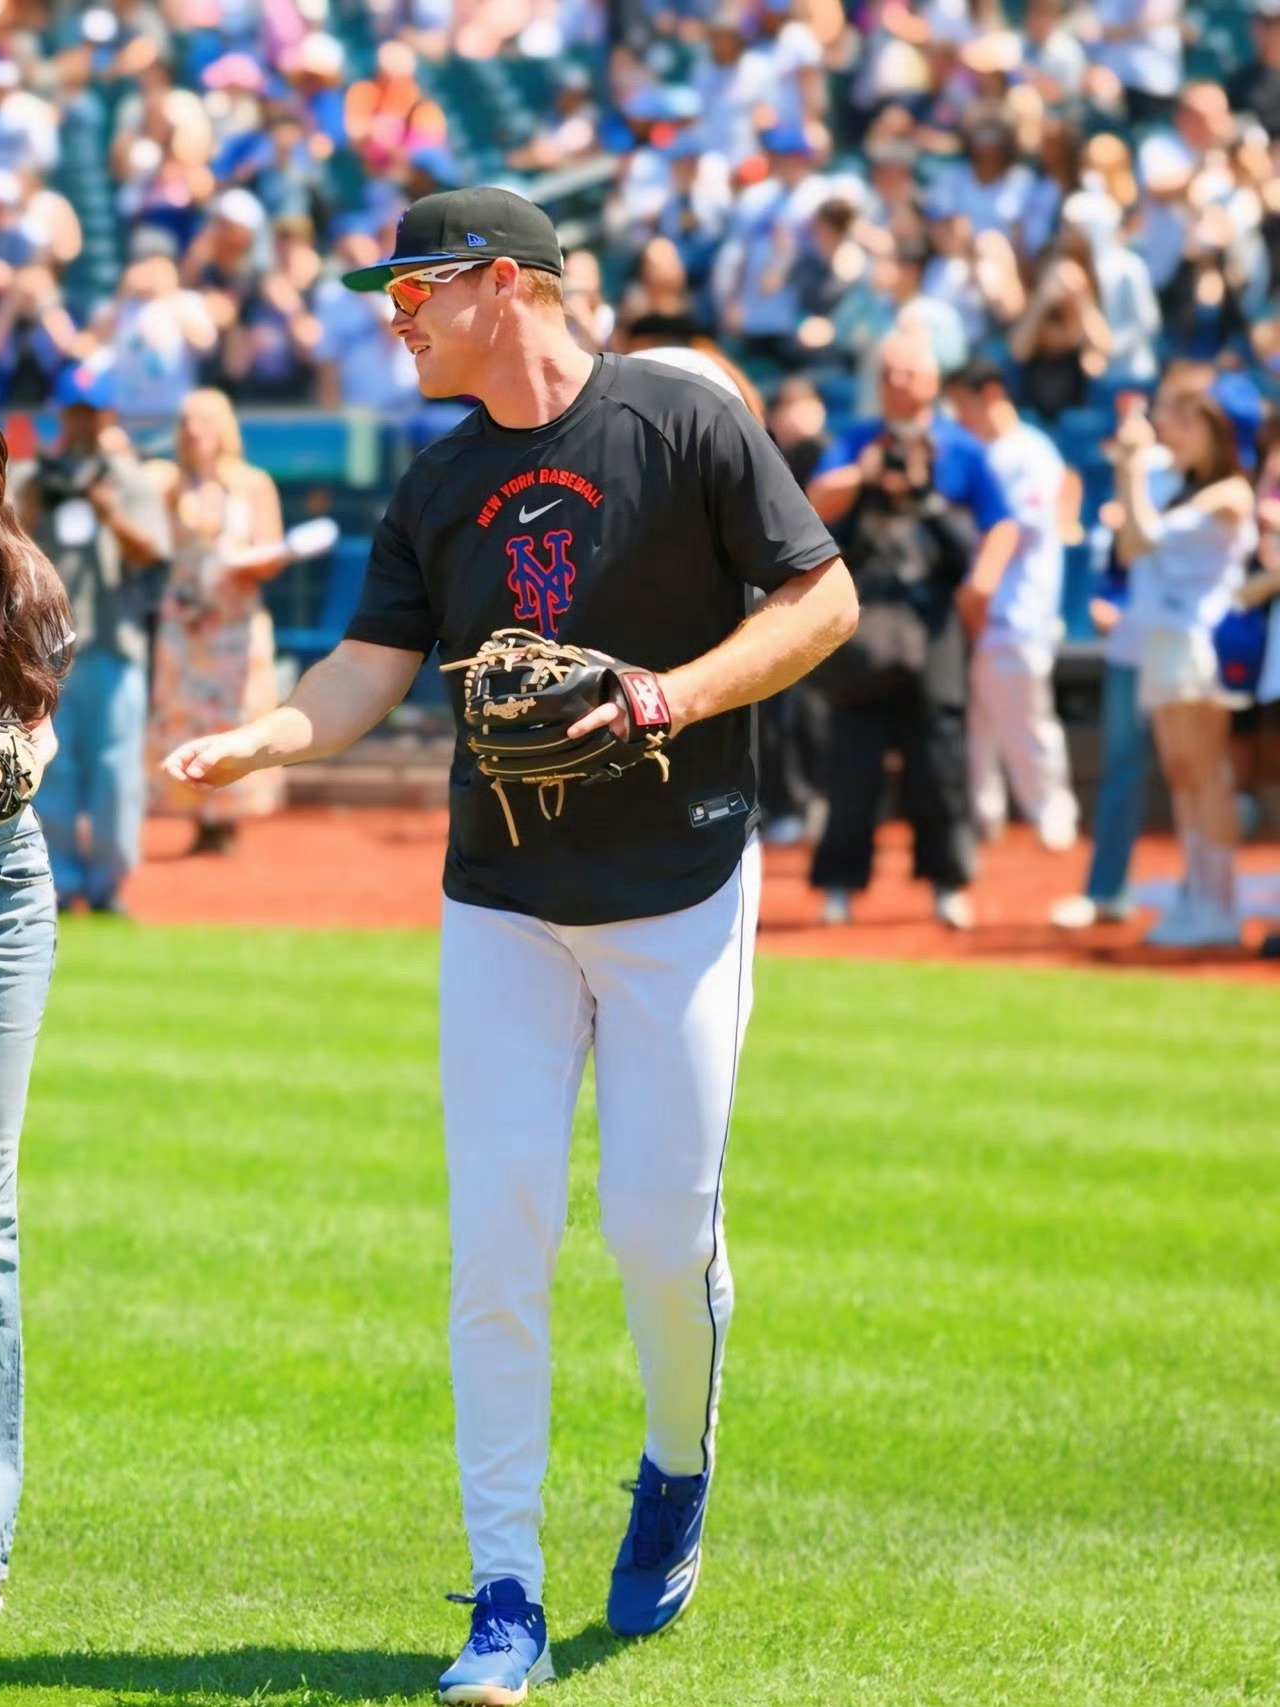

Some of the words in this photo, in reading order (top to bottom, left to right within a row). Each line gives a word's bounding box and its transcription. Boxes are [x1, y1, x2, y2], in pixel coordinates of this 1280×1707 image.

[477, 494, 502, 528] NEW
[500, 471, 535, 498] YORK
[539, 468, 603, 508] BASEBALL
